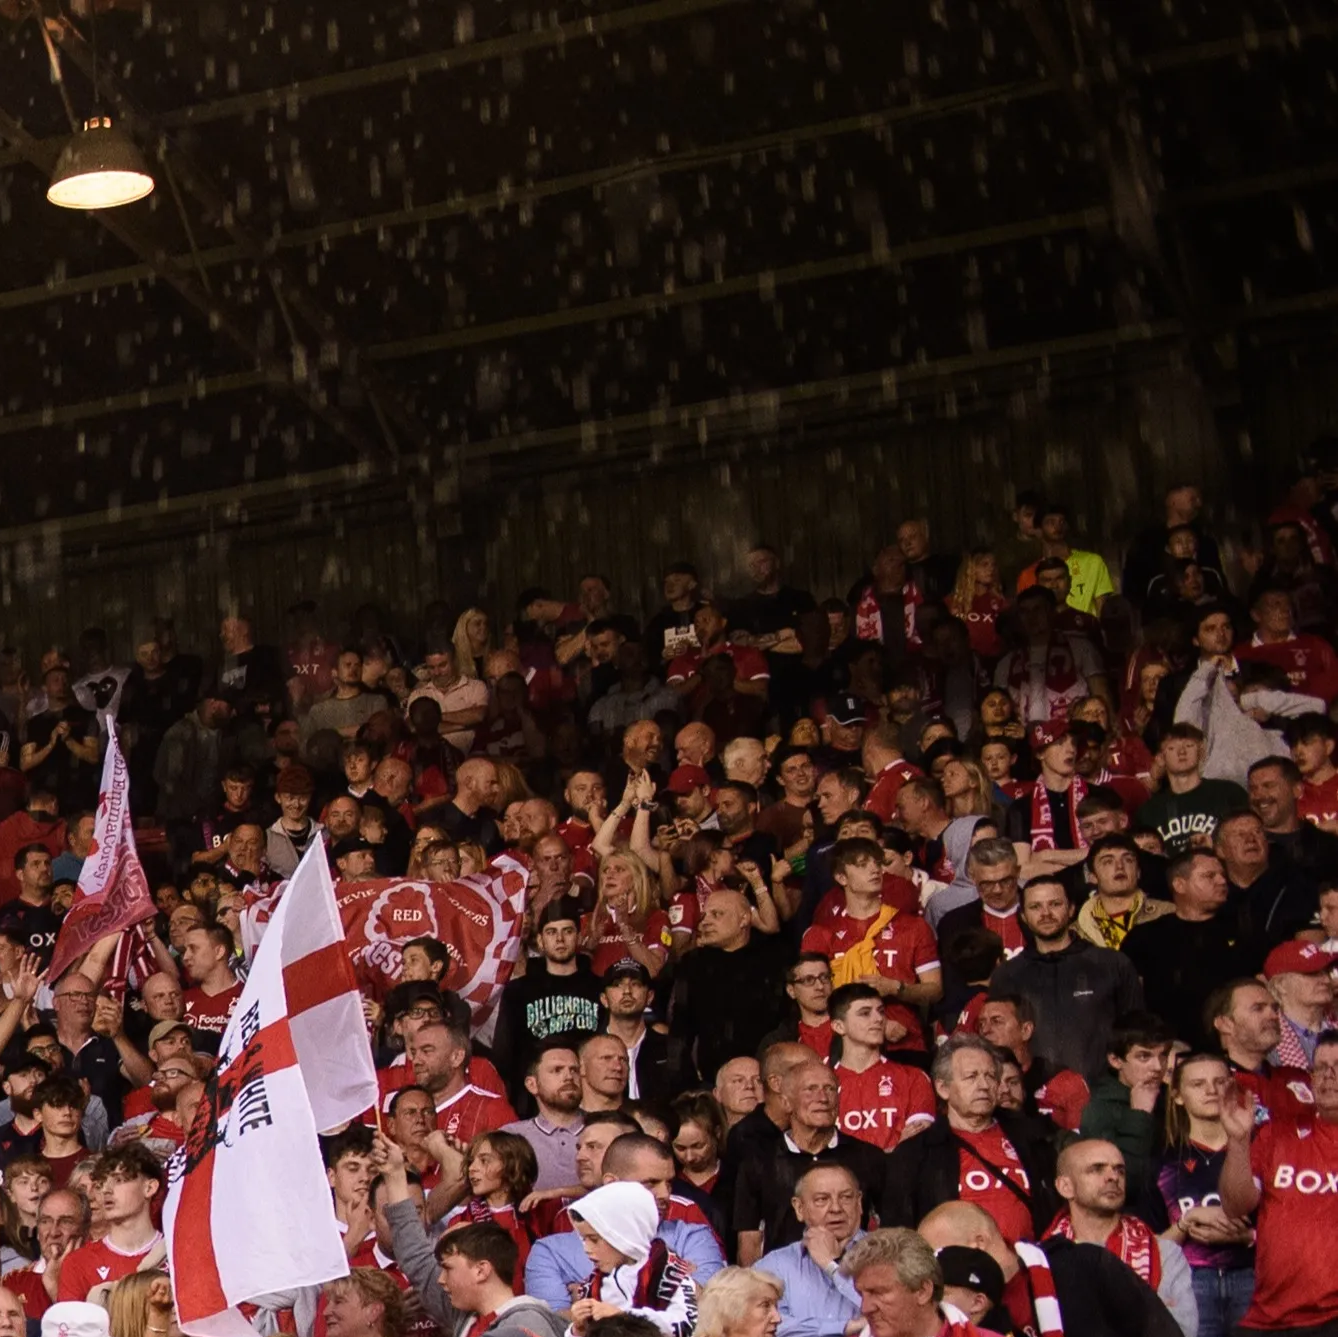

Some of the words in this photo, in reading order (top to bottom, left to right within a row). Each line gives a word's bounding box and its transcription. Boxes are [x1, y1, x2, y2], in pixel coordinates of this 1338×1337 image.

[336, 888, 377, 909] TEVIE
[392, 908, 423, 922] RED
[29, 932, 57, 948] OX
[441, 940, 469, 968] RMY
[198, 1014, 230, 1025] Footb
